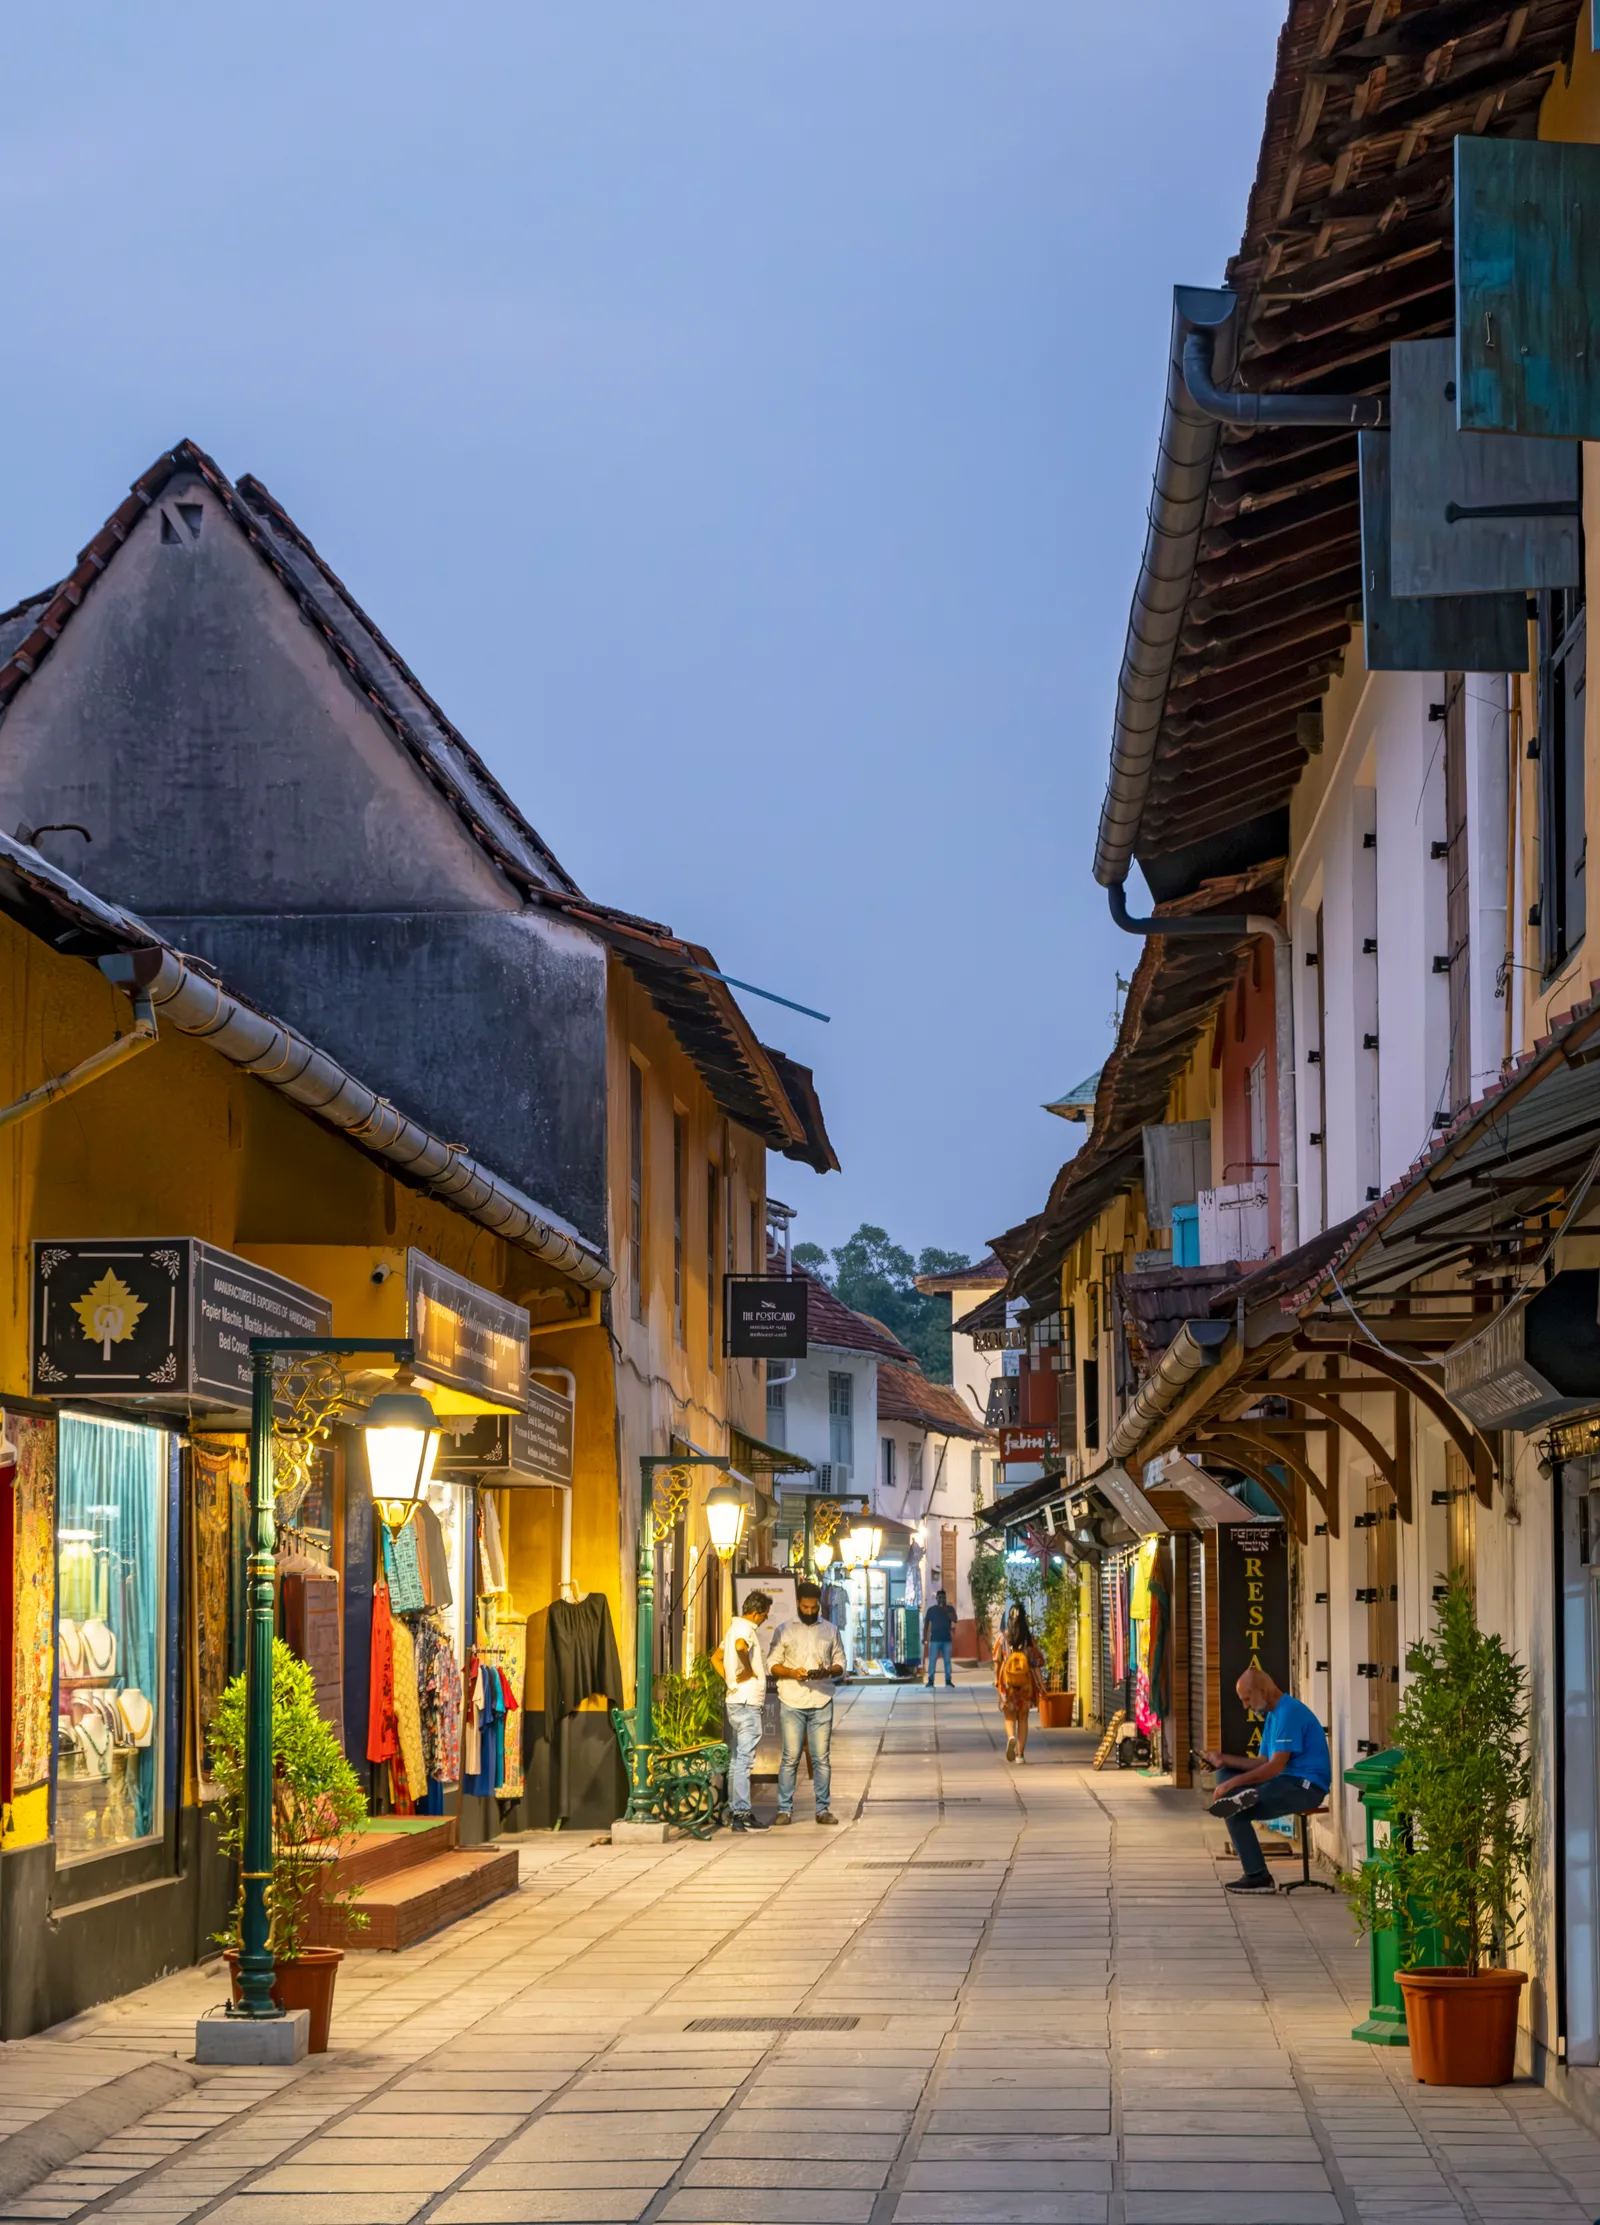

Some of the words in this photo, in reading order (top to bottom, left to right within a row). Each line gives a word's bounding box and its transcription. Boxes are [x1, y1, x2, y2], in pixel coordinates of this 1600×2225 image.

[252, 1293, 255, 1305] &
[257, 1295, 281, 1316] EXPORTERS
[282, 1306, 288, 1319] OF
[202, 1299, 221, 1321] Papier
[244, 1315, 262, 1335] Marble
[742, 1311, 754, 1321] THE
[755, 1311, 796, 1321] POSTCARD
[219, 1332, 230, 1350] Bed
[238, 1364, 253, 1383] Pash
